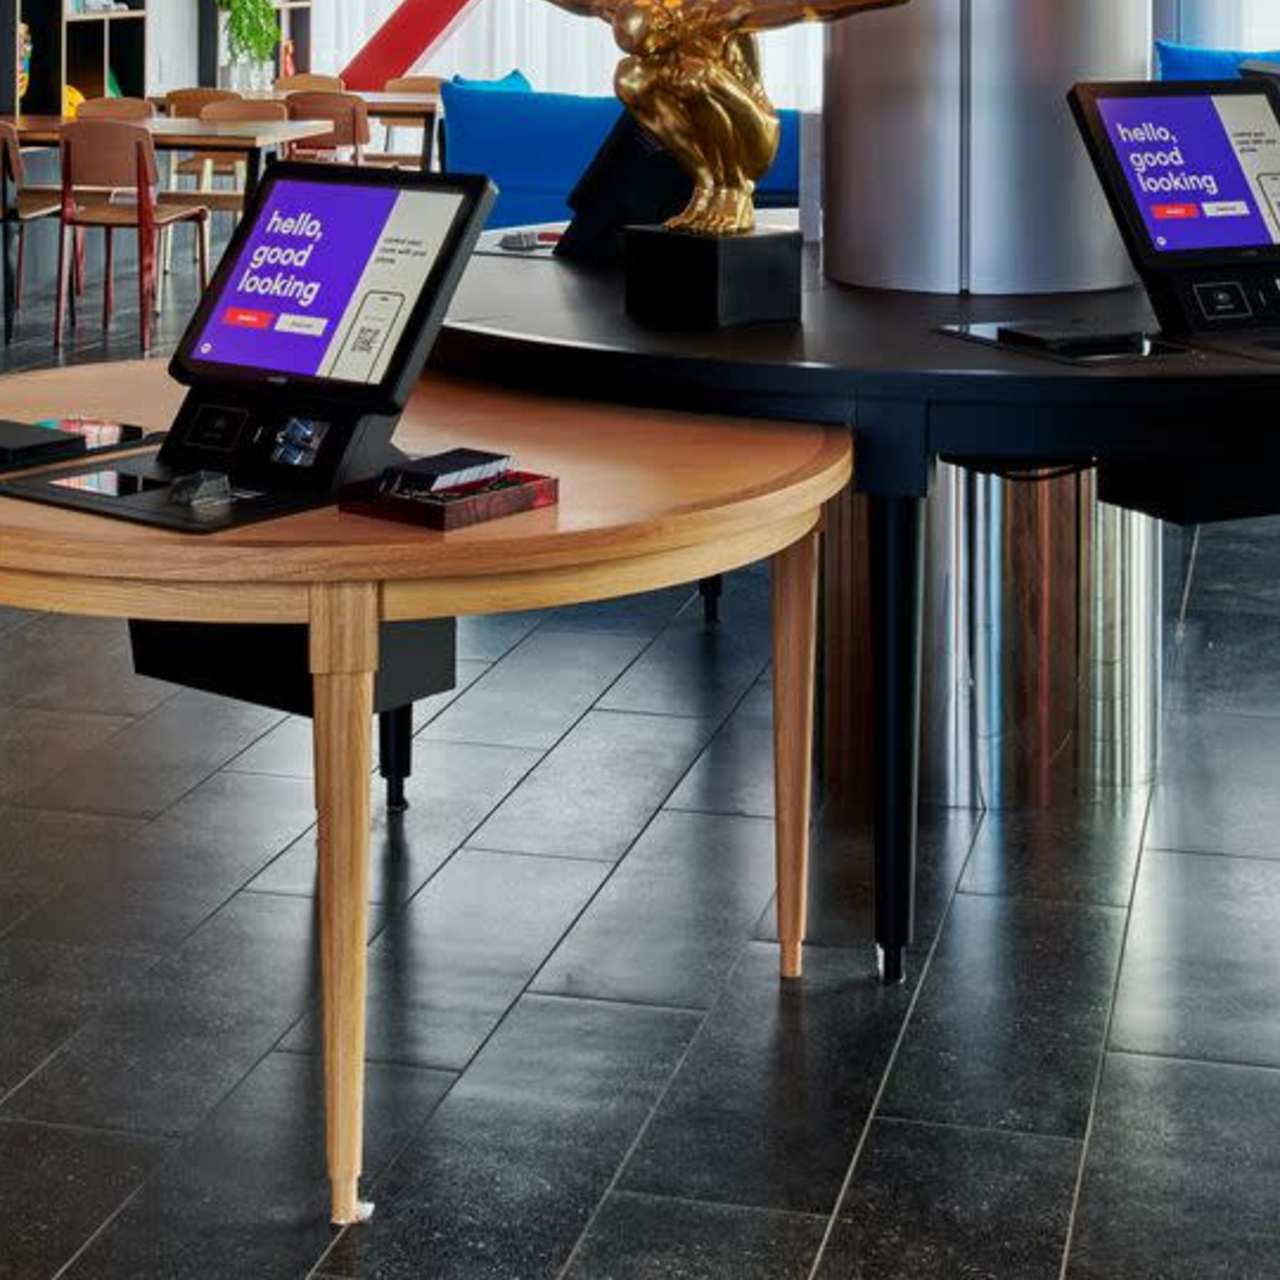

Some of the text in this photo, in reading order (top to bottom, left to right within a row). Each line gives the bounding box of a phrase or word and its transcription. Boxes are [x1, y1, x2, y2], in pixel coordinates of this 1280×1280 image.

[1116, 122, 1178, 144] hello,
[1129, 146, 1185, 173] good
[1136, 171, 1219, 195] looking
[266, 209, 324, 242] hello,
[249, 243, 315, 269] good
[236, 268, 321, 308] looking
